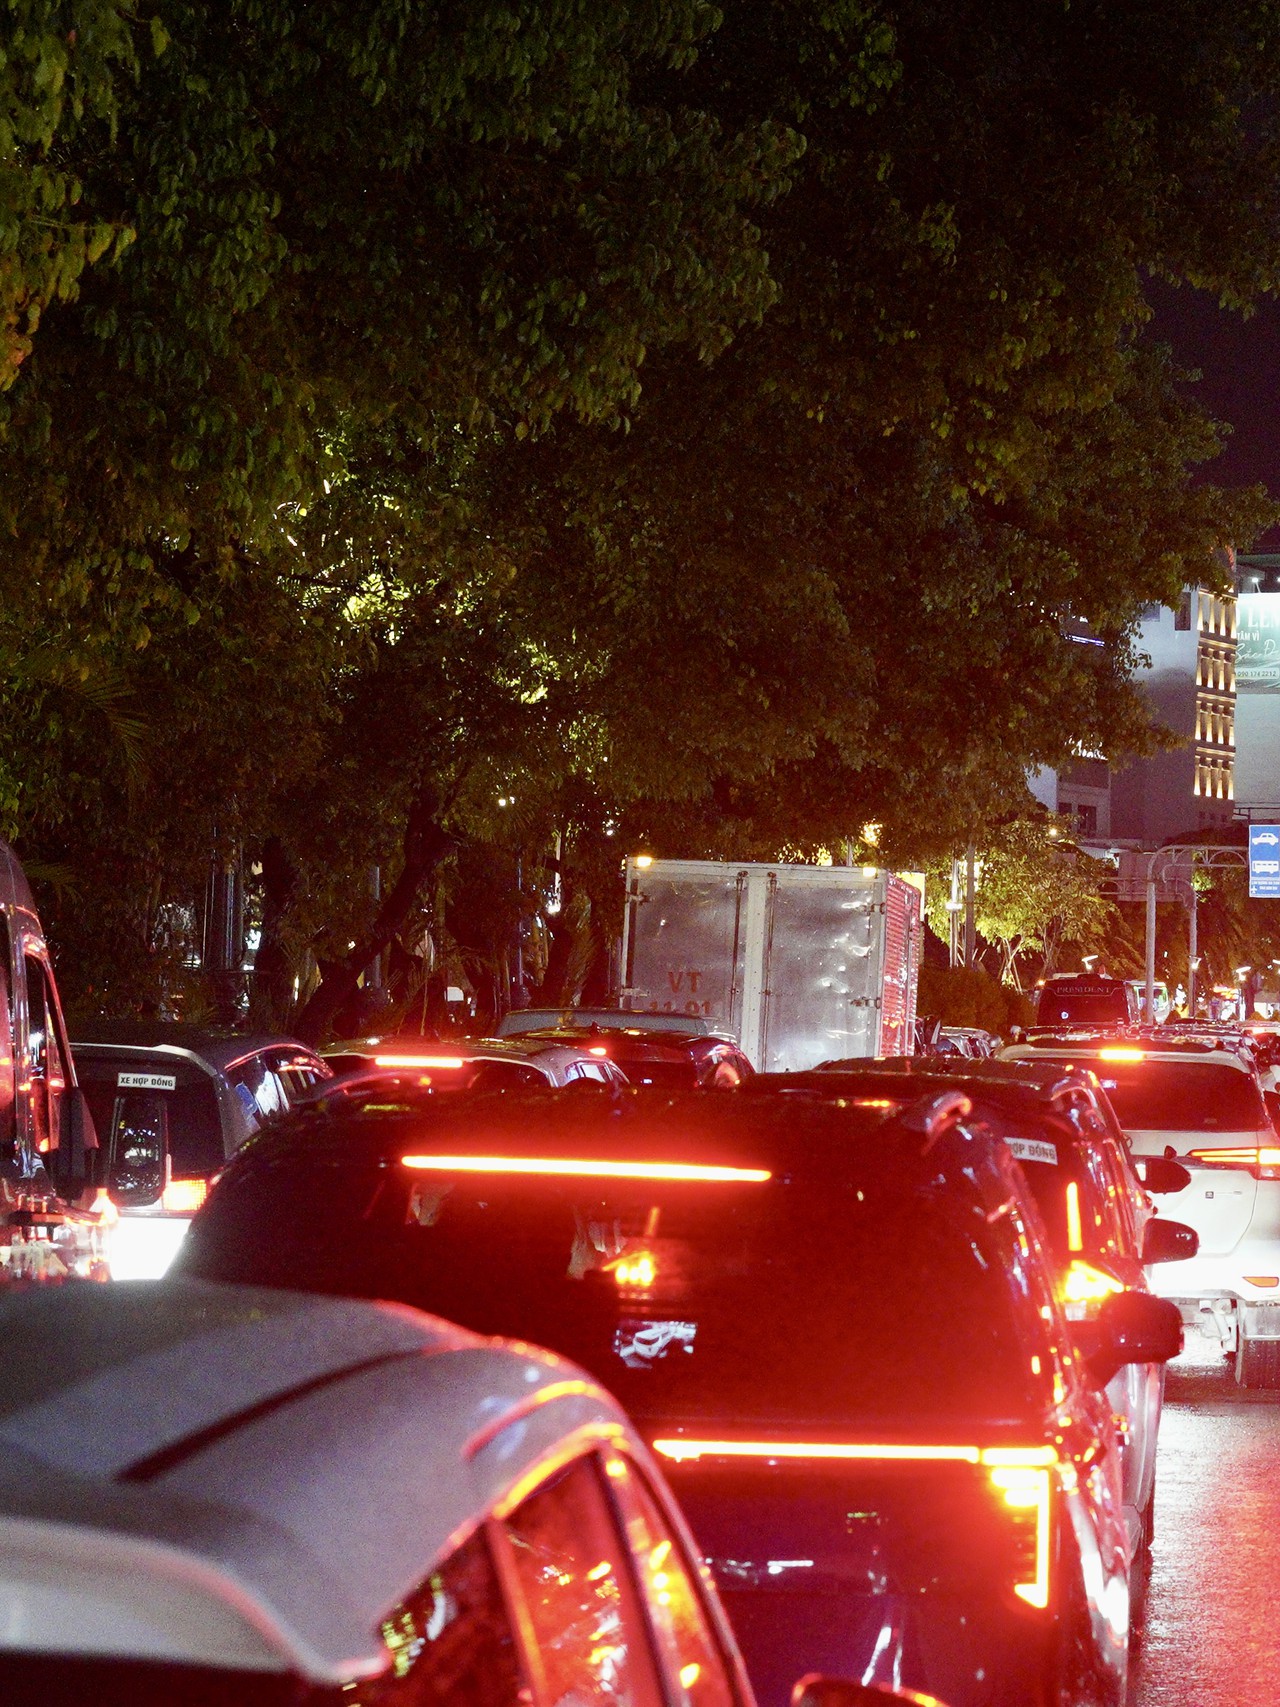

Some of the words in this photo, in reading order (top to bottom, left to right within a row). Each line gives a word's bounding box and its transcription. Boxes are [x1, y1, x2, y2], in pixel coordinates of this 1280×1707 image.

[668, 971, 702, 993] VT
[120, 1076, 131, 1084] XE
[132, 1077, 149, 1086] HỢP
[151, 1078, 173, 1087] ĐỒNG
